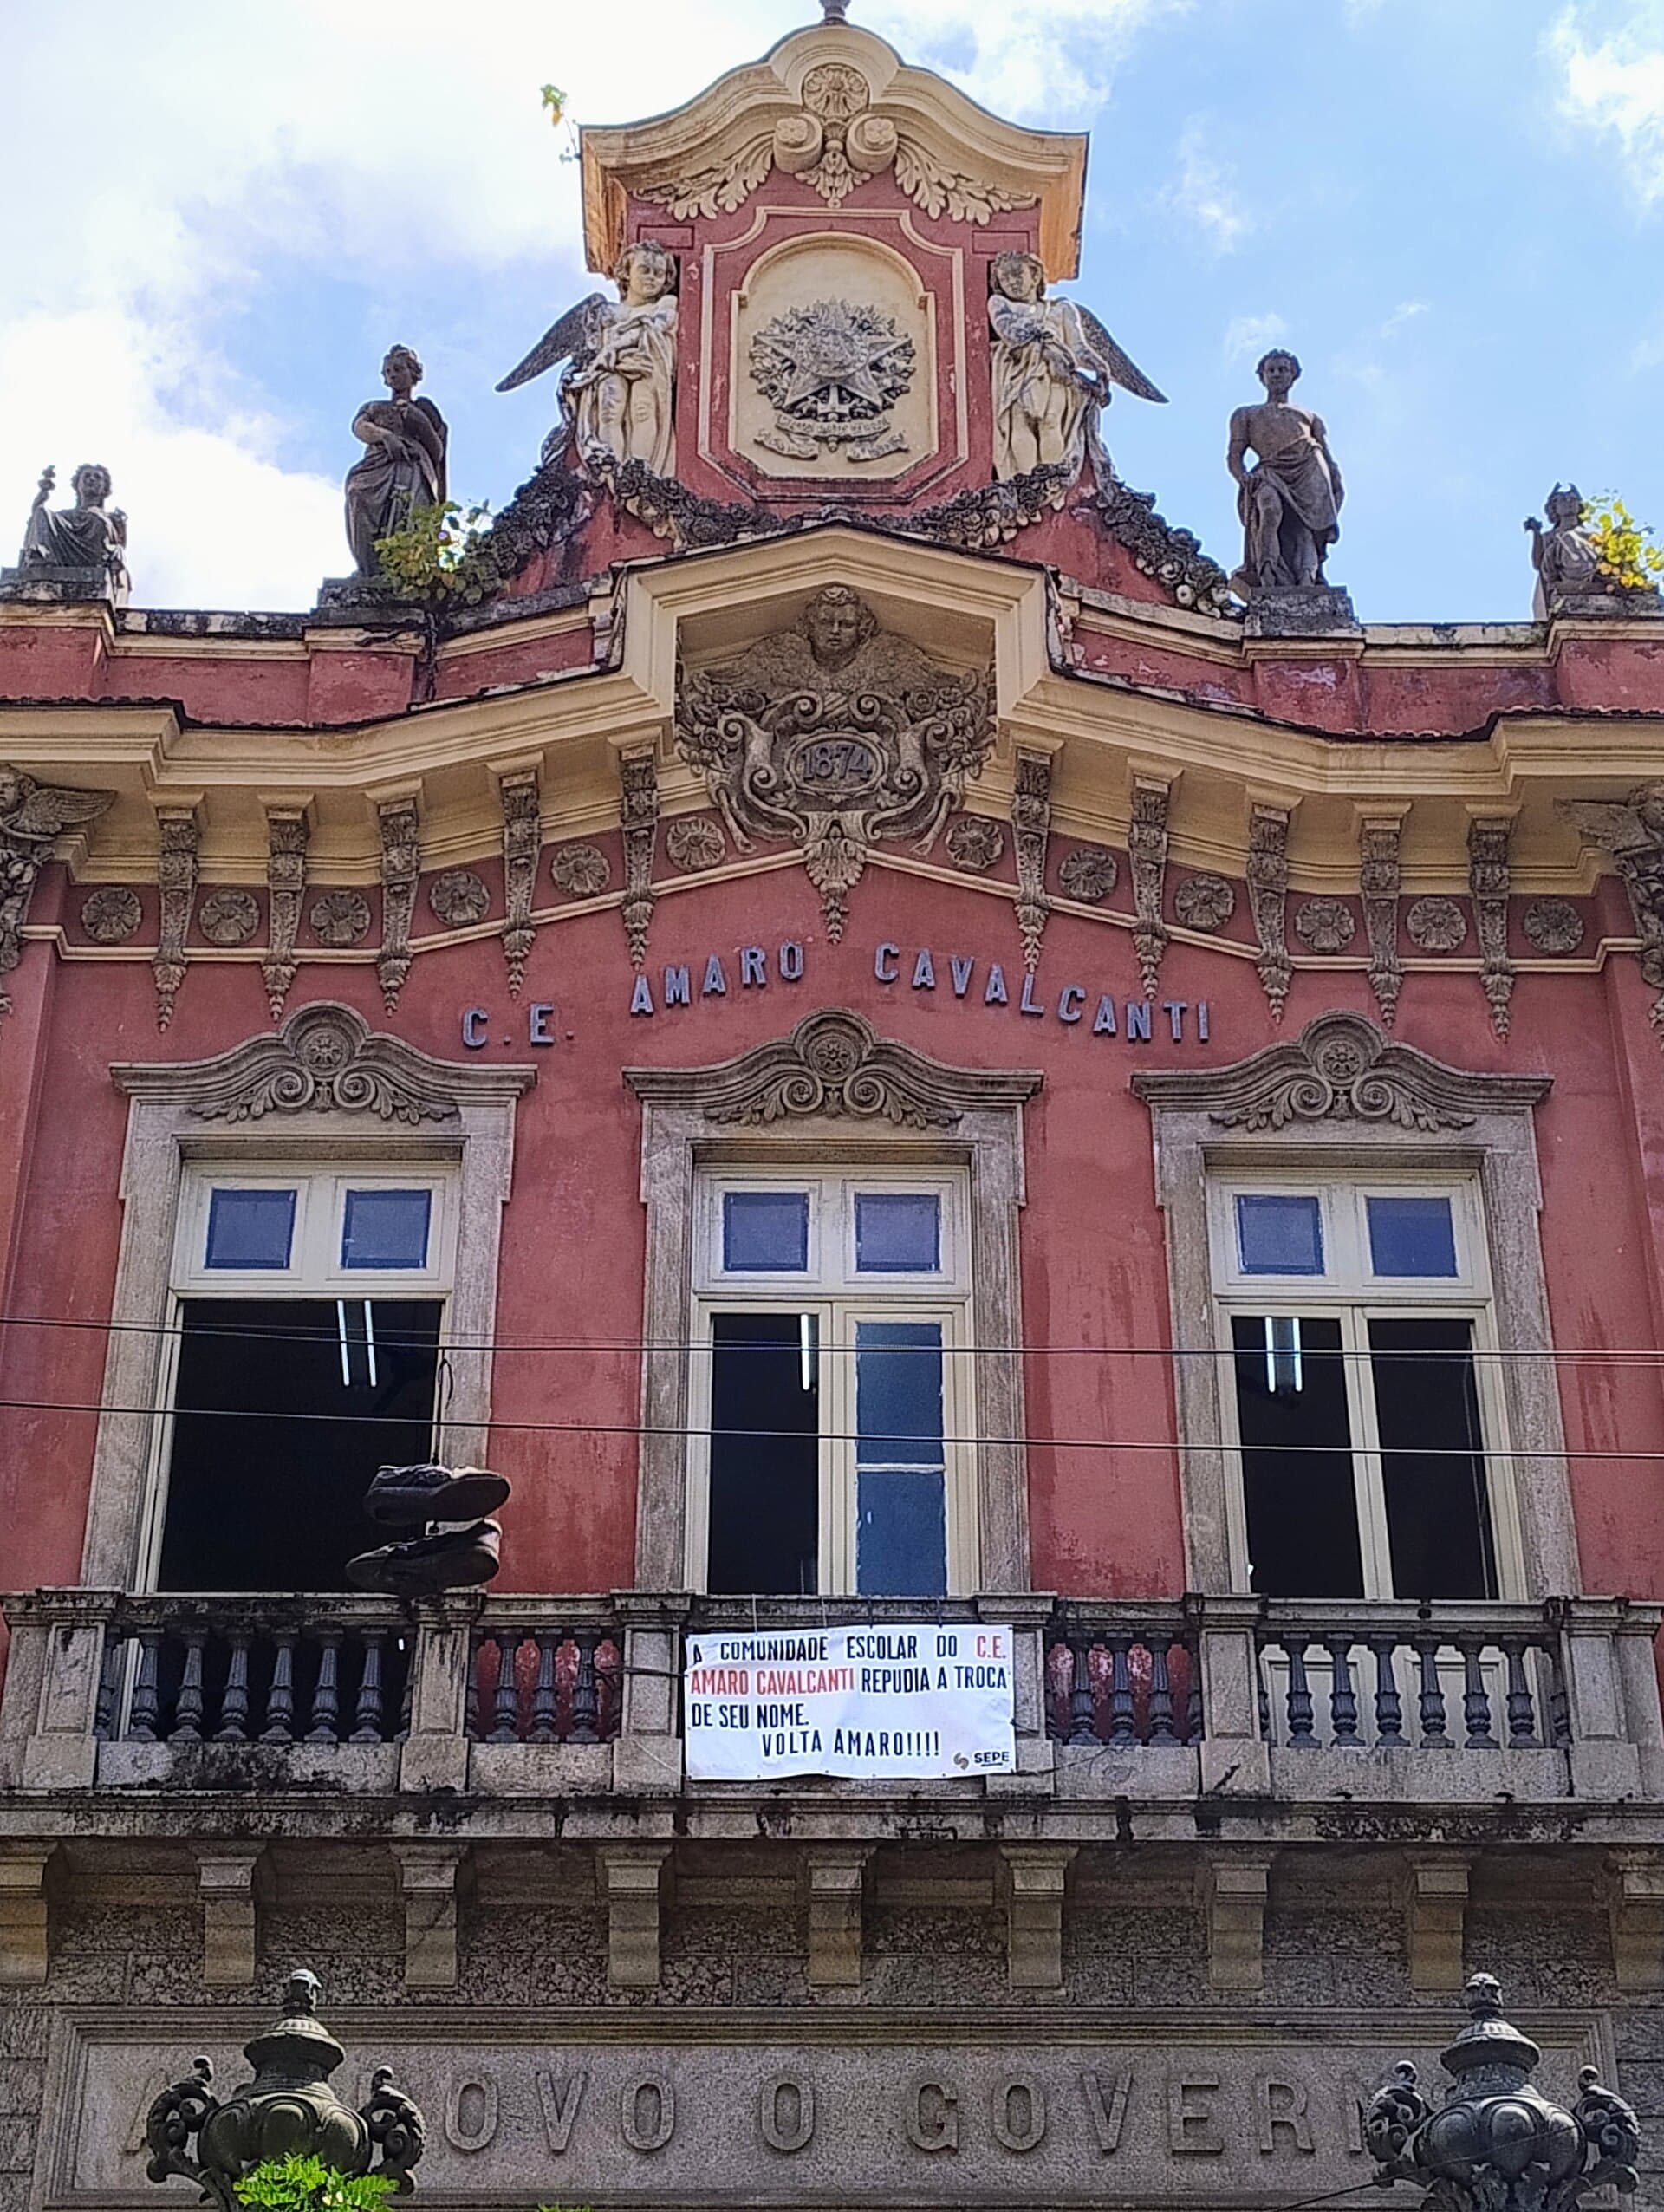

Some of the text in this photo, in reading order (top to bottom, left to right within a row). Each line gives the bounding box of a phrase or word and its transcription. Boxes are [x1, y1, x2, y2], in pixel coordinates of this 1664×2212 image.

[801, 745, 873, 781] 1874
[630, 940, 806, 1017] AMARO
[874, 942, 1211, 1041] CAVALCANTI
[692, 1635, 1007, 1665] A COMUNIDADE ESCOLAR DO C.E.
[691, 1665, 1007, 1695] AMARO CAVALCANTI REPUDIA A TROCA
[692, 1703, 809, 1729] DE SEU NOME.
[762, 1728, 939, 1757] VOLTA AMARO!!!!
[974, 1751, 1011, 1765] SEPE
[357, 2068, 1456, 2154] OVO O GOVER
